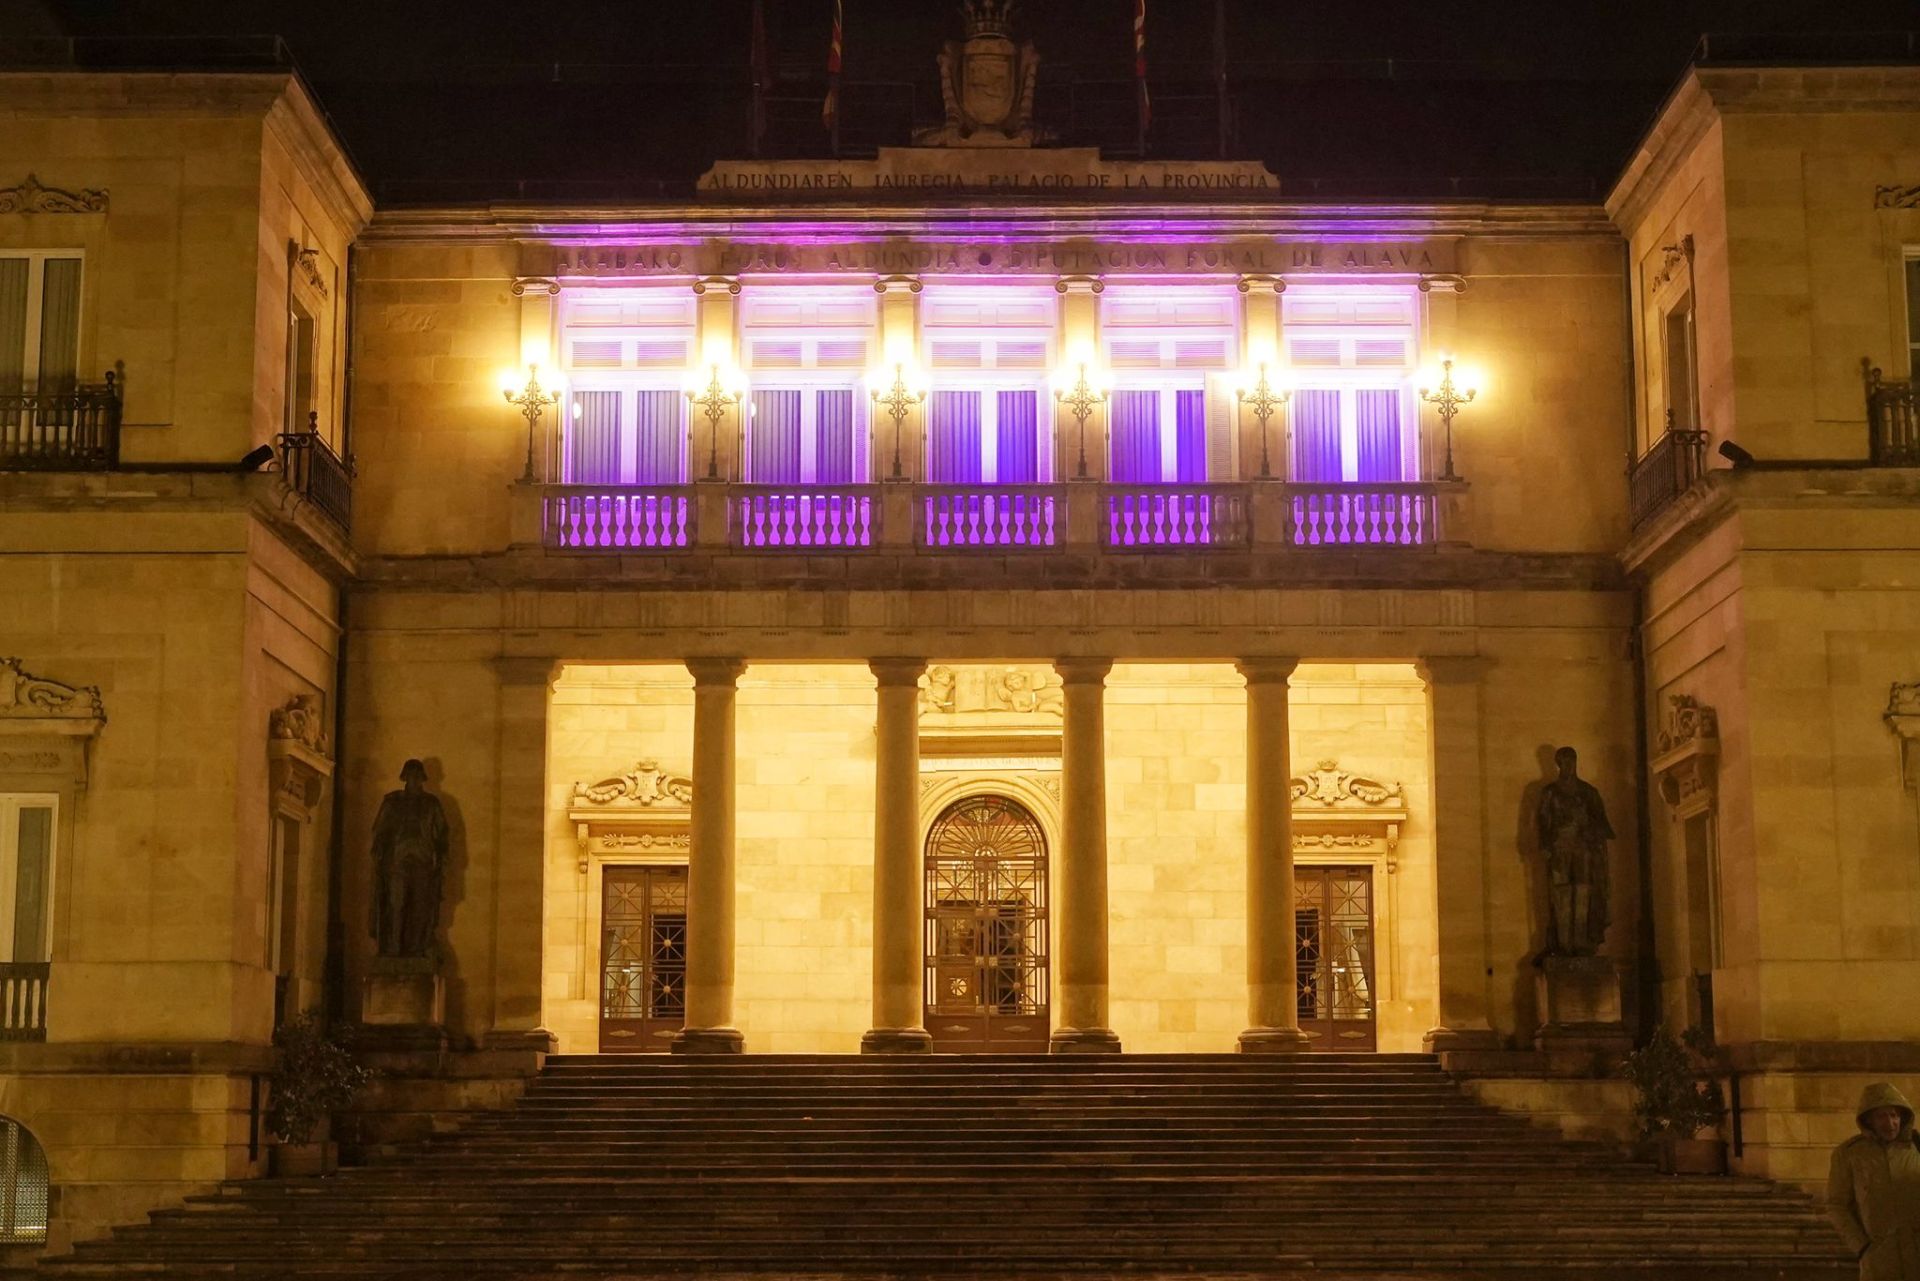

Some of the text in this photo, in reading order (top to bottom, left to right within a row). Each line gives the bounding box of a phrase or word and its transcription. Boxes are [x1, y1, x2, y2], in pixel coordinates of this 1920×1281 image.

[708, 173, 852, 189] ALDUNDIAREN
[988, 174, 1074, 188] PALACIO
[1087, 174, 1110, 188] DE
[1124, 174, 1148, 188] LA
[1163, 174, 1268, 188] PROVINCIA
[558, 252, 682, 271] ARABAKO
[721, 251, 788, 270] FORU
[827, 250, 960, 270] ALDUNDIA
[1186, 249, 1271, 268] FORAL
[1292, 250, 1322, 267] DE
